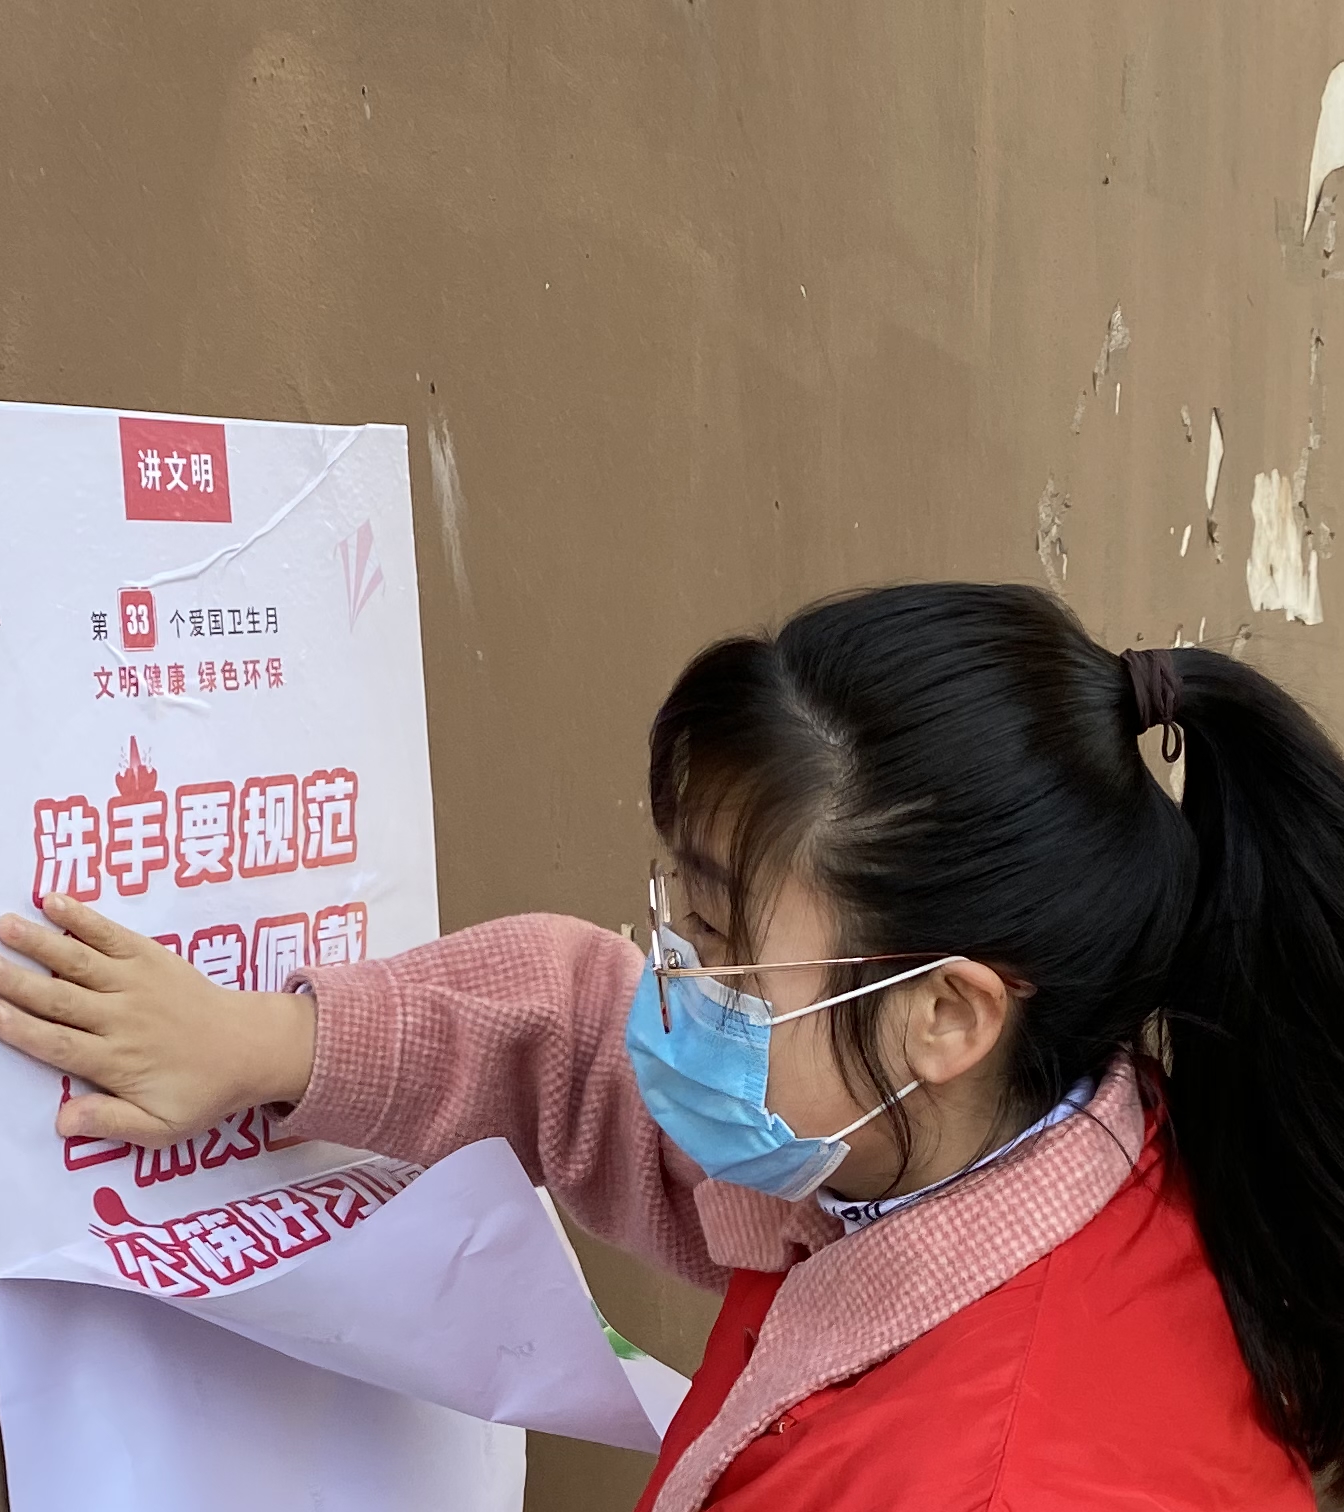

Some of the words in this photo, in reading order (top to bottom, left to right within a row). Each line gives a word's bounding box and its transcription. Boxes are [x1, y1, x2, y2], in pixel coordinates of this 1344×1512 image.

[137, 449, 214, 493] 讲文明
[93, 664, 187, 699] 文明健康
[197, 657, 285, 693] 绿色环保
[36, 770, 357, 905] 洗手要规范
